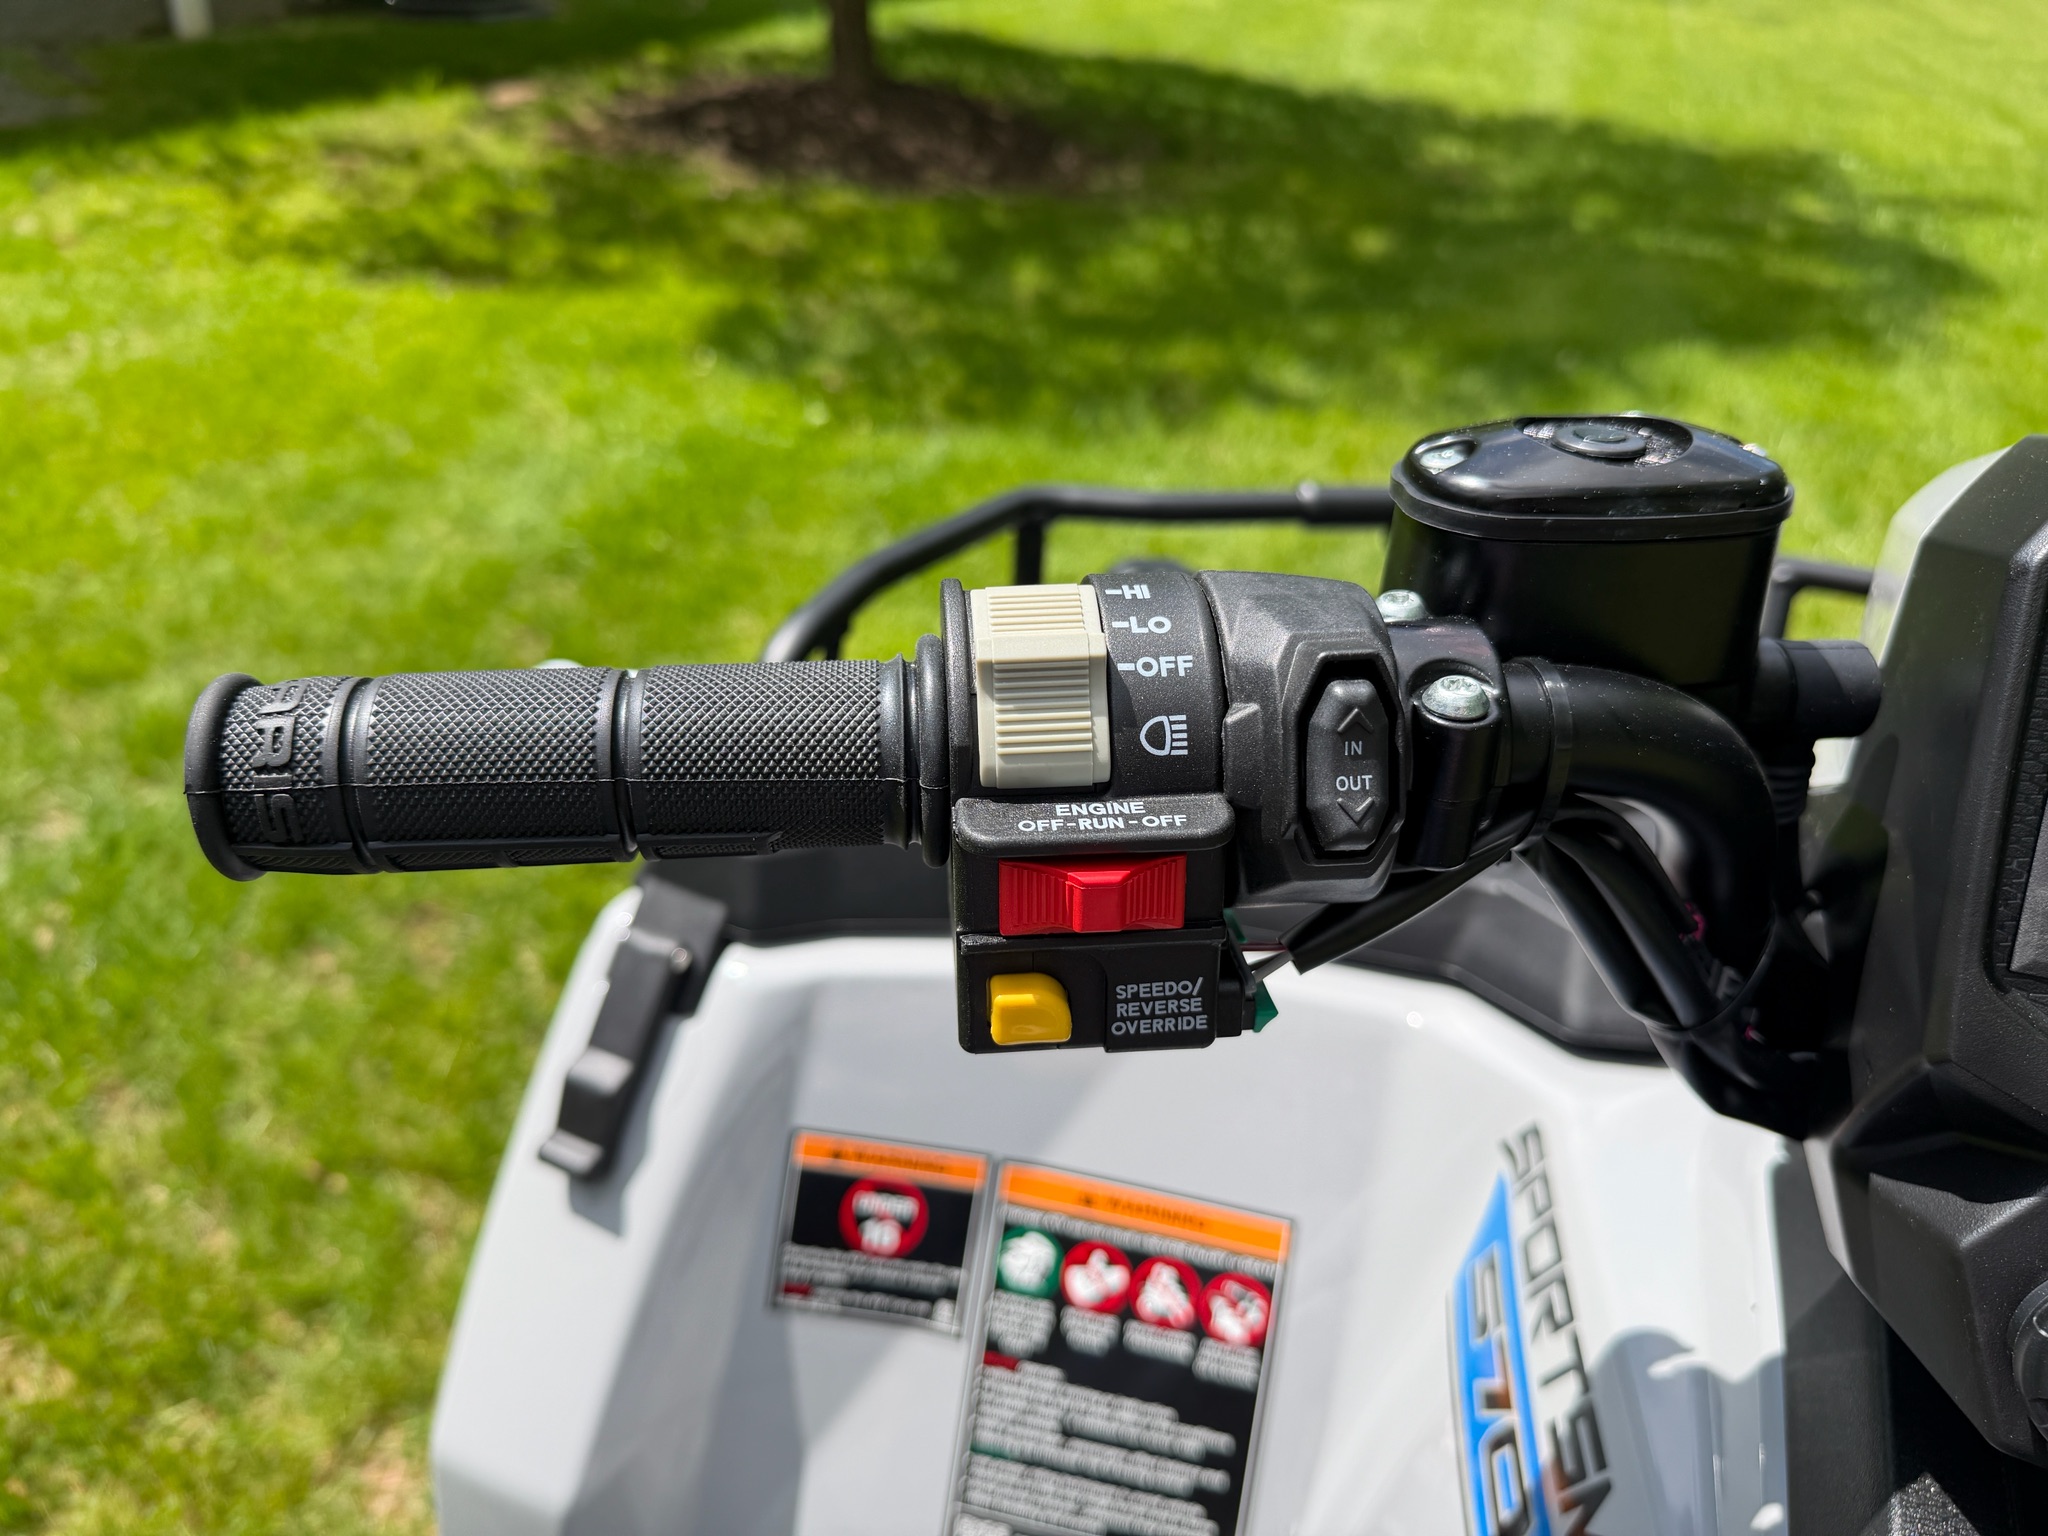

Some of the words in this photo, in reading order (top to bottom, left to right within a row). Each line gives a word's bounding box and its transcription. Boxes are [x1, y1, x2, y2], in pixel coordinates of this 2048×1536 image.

[1344, 740, 1363, 756] IN
[1335, 775, 1373, 791] OUT
[1055, 801, 1146, 817] ENGINE
[1115, 976, 1203, 999] SPEEDO/
[1116, 997, 1202, 1018] REVERSE
[1110, 1014, 1208, 1036] OVERRIDE
